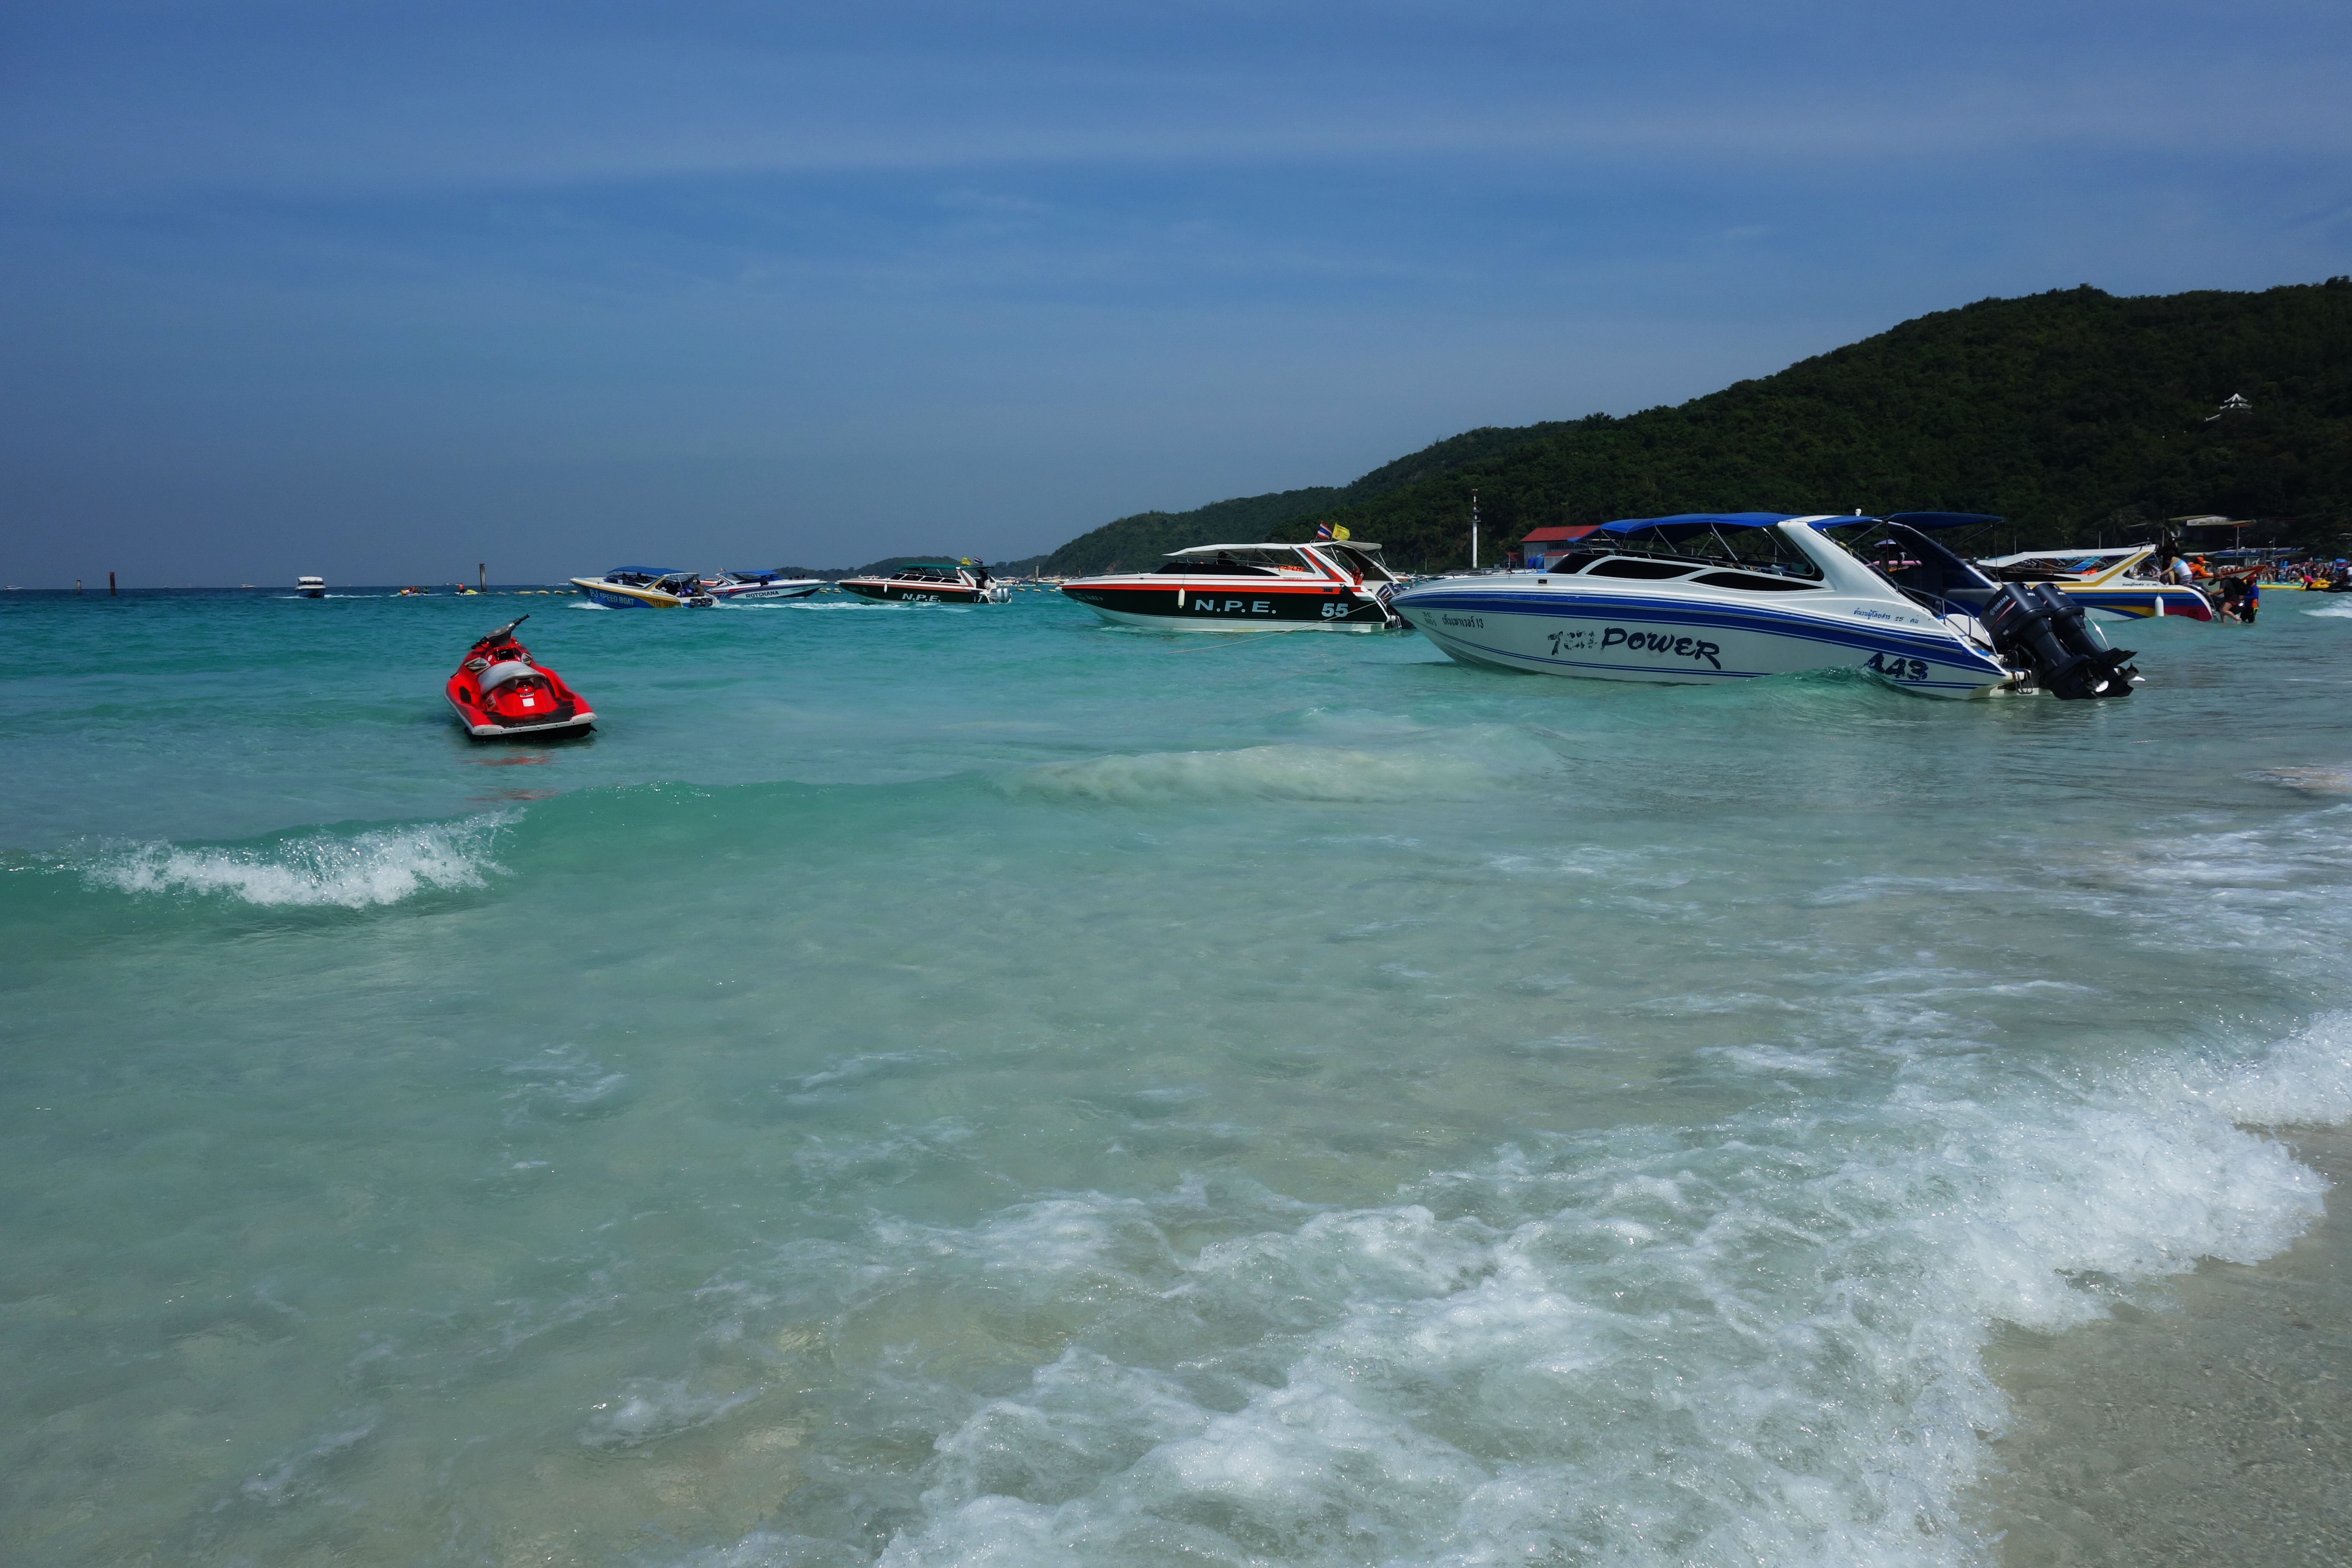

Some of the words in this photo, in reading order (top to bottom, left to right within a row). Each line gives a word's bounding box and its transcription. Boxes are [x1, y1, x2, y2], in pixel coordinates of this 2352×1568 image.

[589, 588, 598, 598] PJ
[619, 596, 634, 606] BOAT
[902, 593, 941, 602] N.P.E.
[1992, 595, 2010, 612] YAMAHA
[1195, 600, 1276, 614] N.P.E.
[1321, 603, 1348, 617] 55
[1476, 618, 1484, 628] 13
[1601, 627, 1721, 670] POWER
